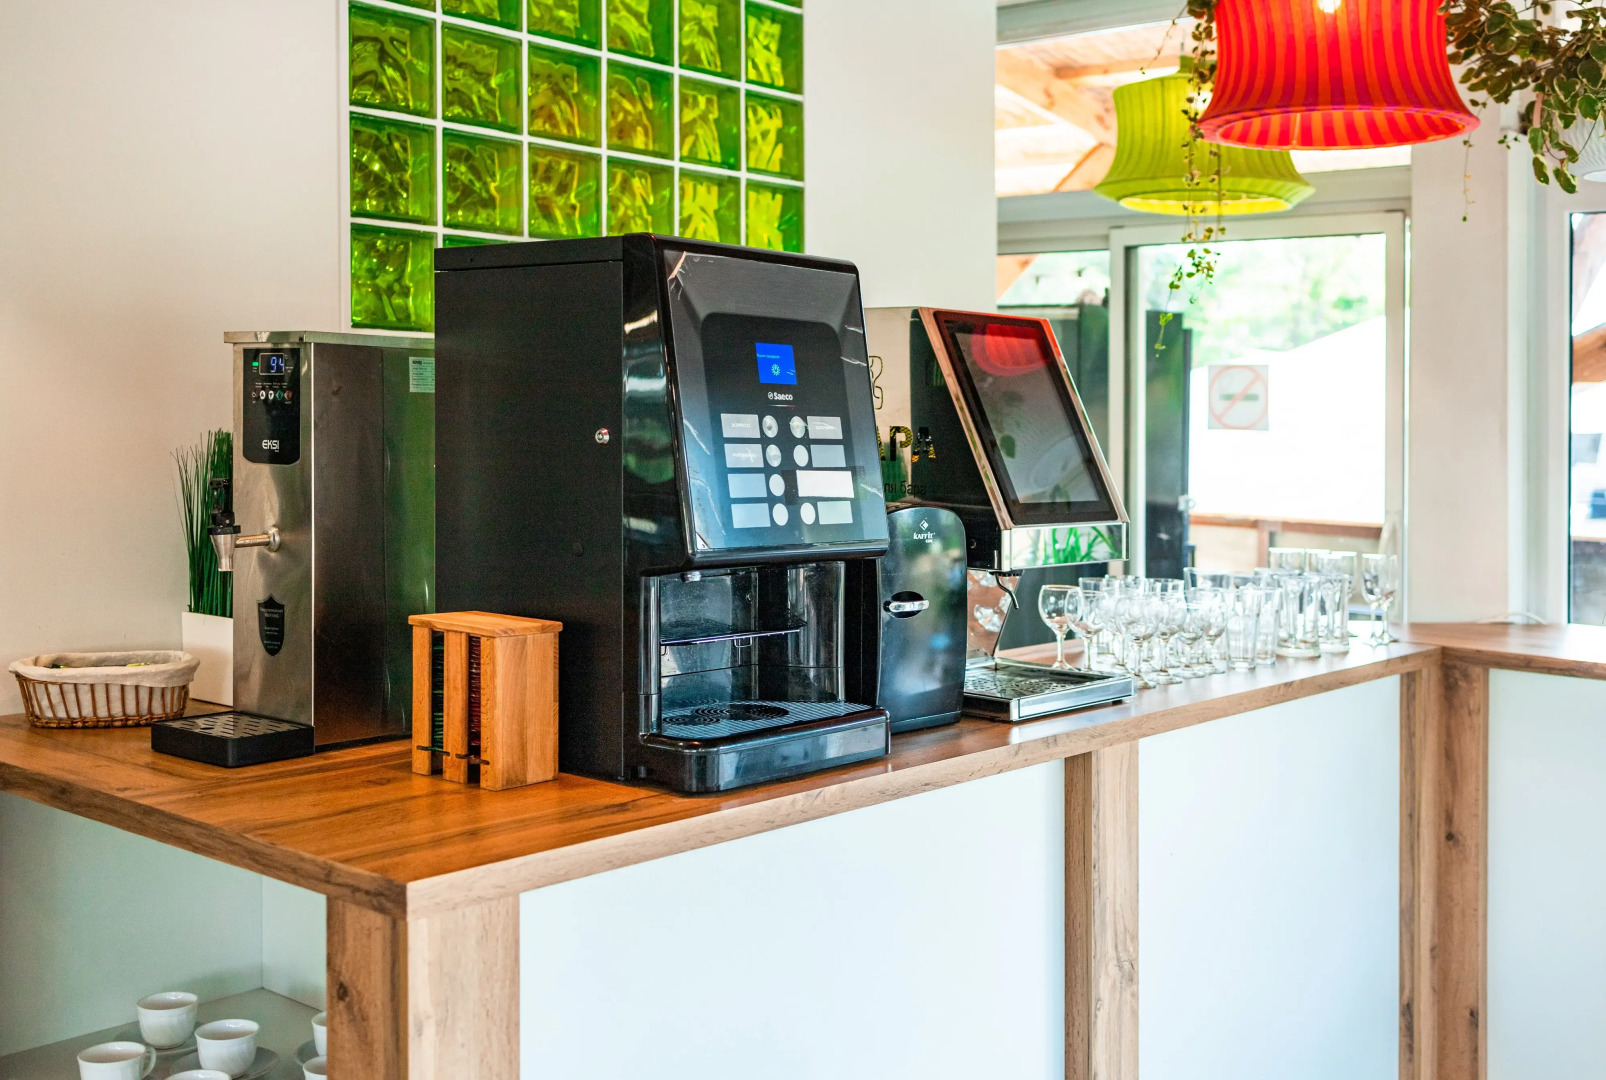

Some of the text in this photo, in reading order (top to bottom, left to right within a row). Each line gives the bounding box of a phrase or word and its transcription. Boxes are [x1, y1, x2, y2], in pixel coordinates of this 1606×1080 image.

[270, 357, 285, 373] 94
[773, 391, 794, 402] Saeco
[261, 439, 280, 450] EKSI
[900, 480, 927, 498] бара
